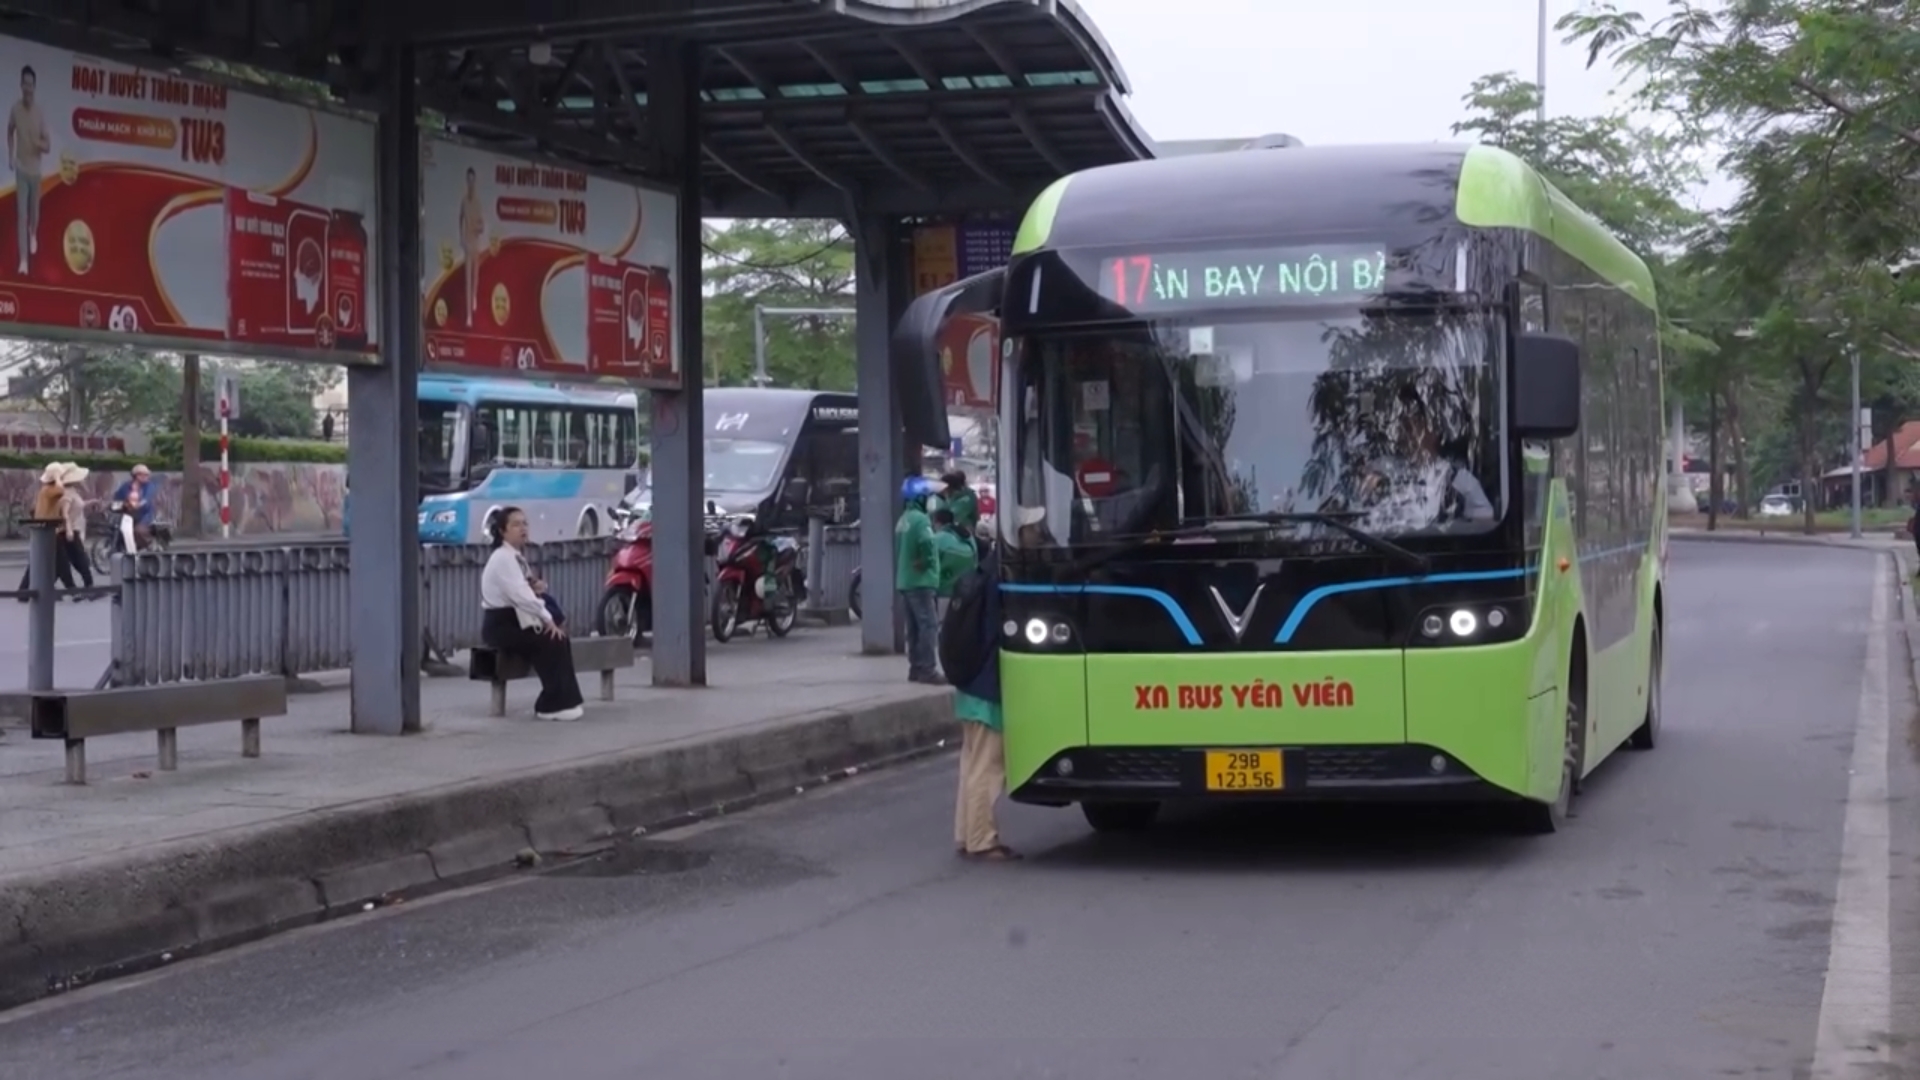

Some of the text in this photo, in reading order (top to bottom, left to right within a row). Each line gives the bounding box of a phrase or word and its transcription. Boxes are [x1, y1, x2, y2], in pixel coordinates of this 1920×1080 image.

[180, 117, 225, 165] TW3
[559, 199, 586, 235] TW3
[1112, 255, 1151, 305] 17
[1204, 264, 1264, 297] BAY
[1278, 253, 1338, 296] NỘI
[1135, 675, 1354, 709] XN BUS YÊN VIÊN
[1227, 753, 1261, 770] 29B
[1216, 772, 1275, 788] 123.56
